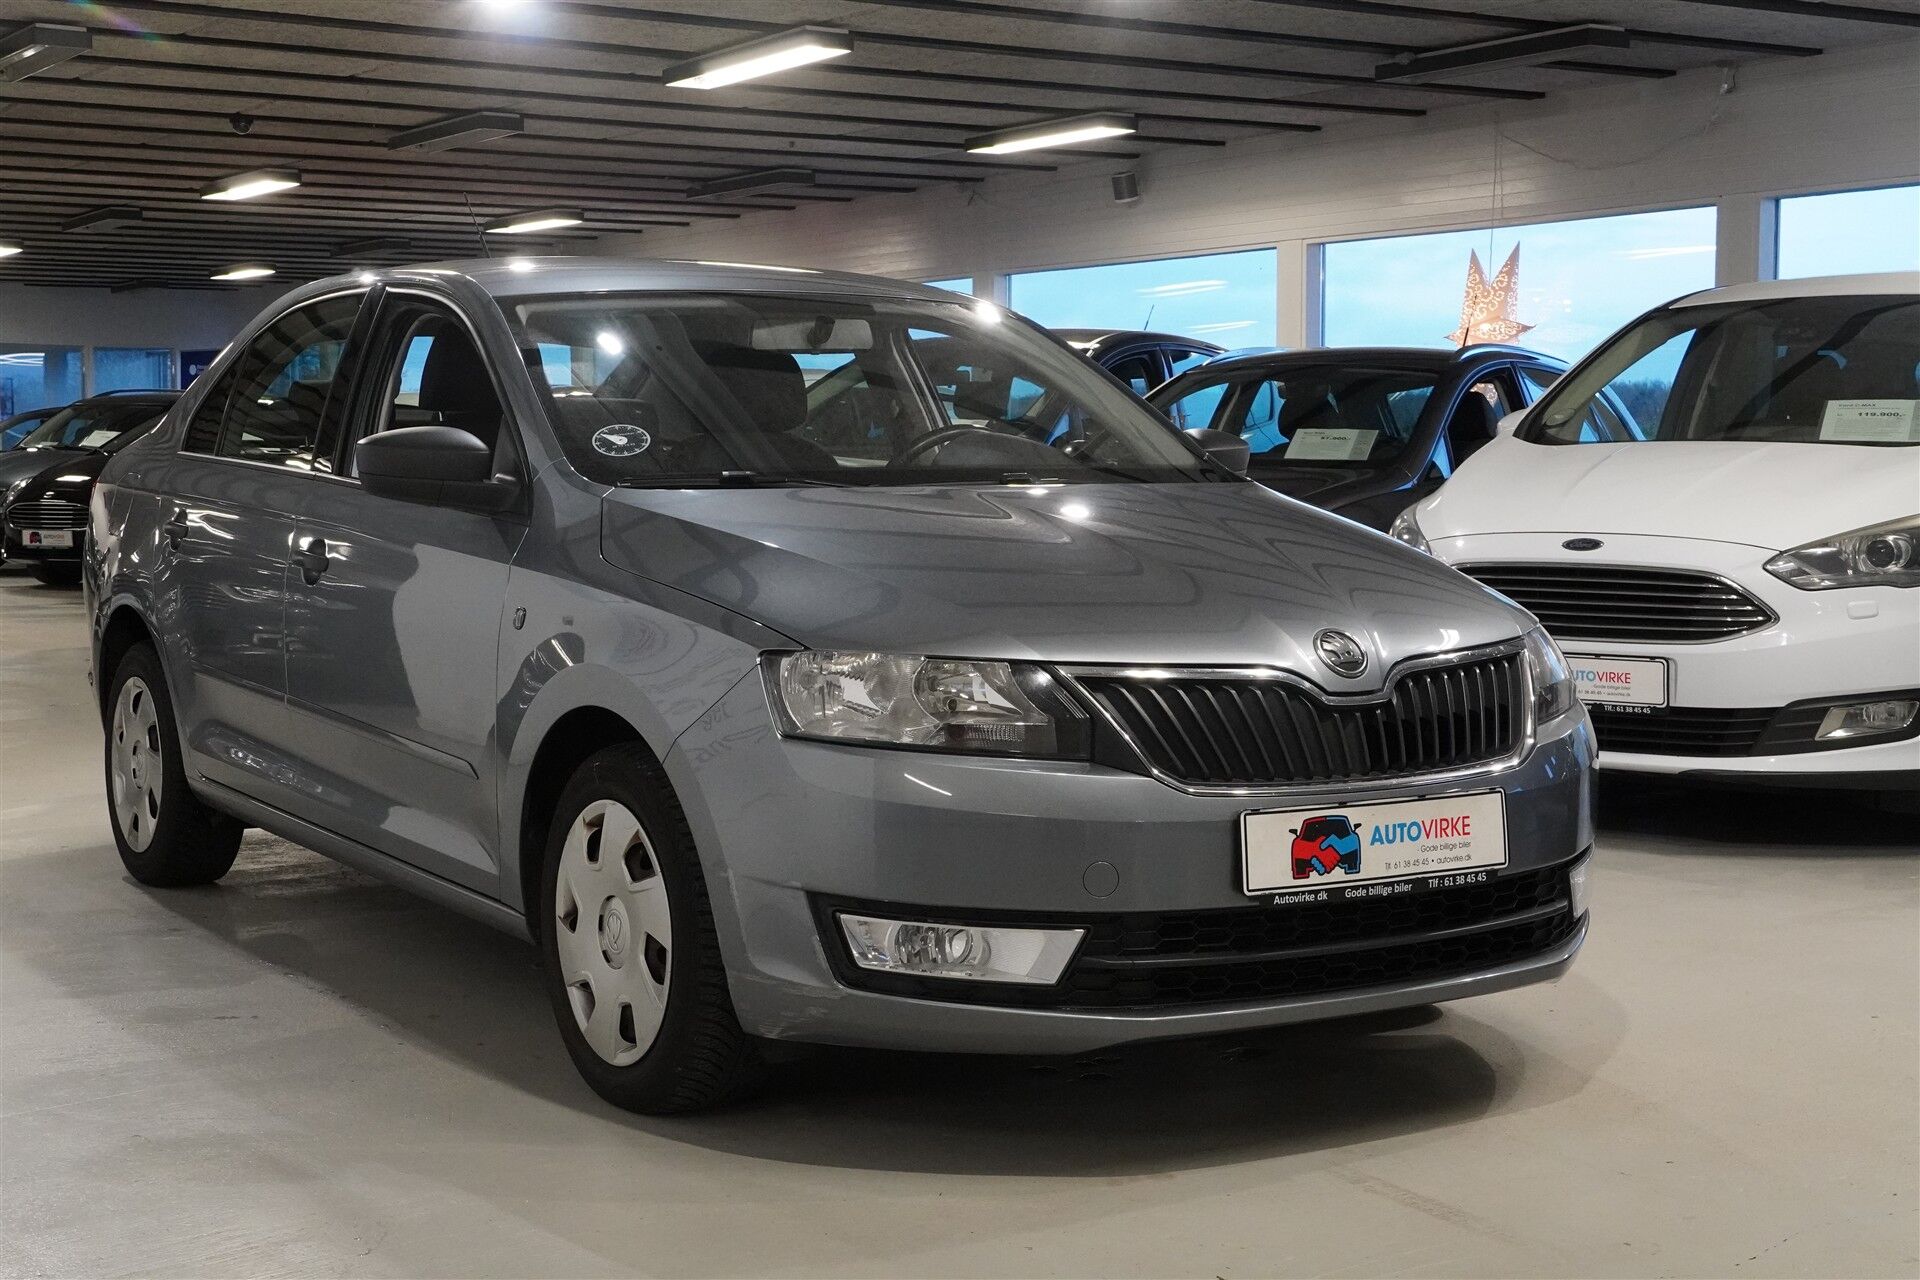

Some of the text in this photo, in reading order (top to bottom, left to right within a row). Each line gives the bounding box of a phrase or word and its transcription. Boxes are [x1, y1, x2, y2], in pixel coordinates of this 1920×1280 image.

[1369, 815, 1471, 846] AUTOVIRKE
[1420, 844, 1439, 853] Gode
[1439, 842, 1458, 852] billige
[1393, 861, 1402, 869] 61
[1403, 860, 1412, 868] 38
[1412, 859, 1420, 867] 45
[1421, 857, 1430, 866] 45
[1344, 887, 1367, 898] Gode
[1368, 884, 1393, 896] billige
[1394, 882, 1413, 893] biler
[1444, 877, 1454, 887] 61
[1455, 875, 1465, 885] 38
[1466, 873, 1476, 883] 45
[1477, 872, 1487, 882] 45
